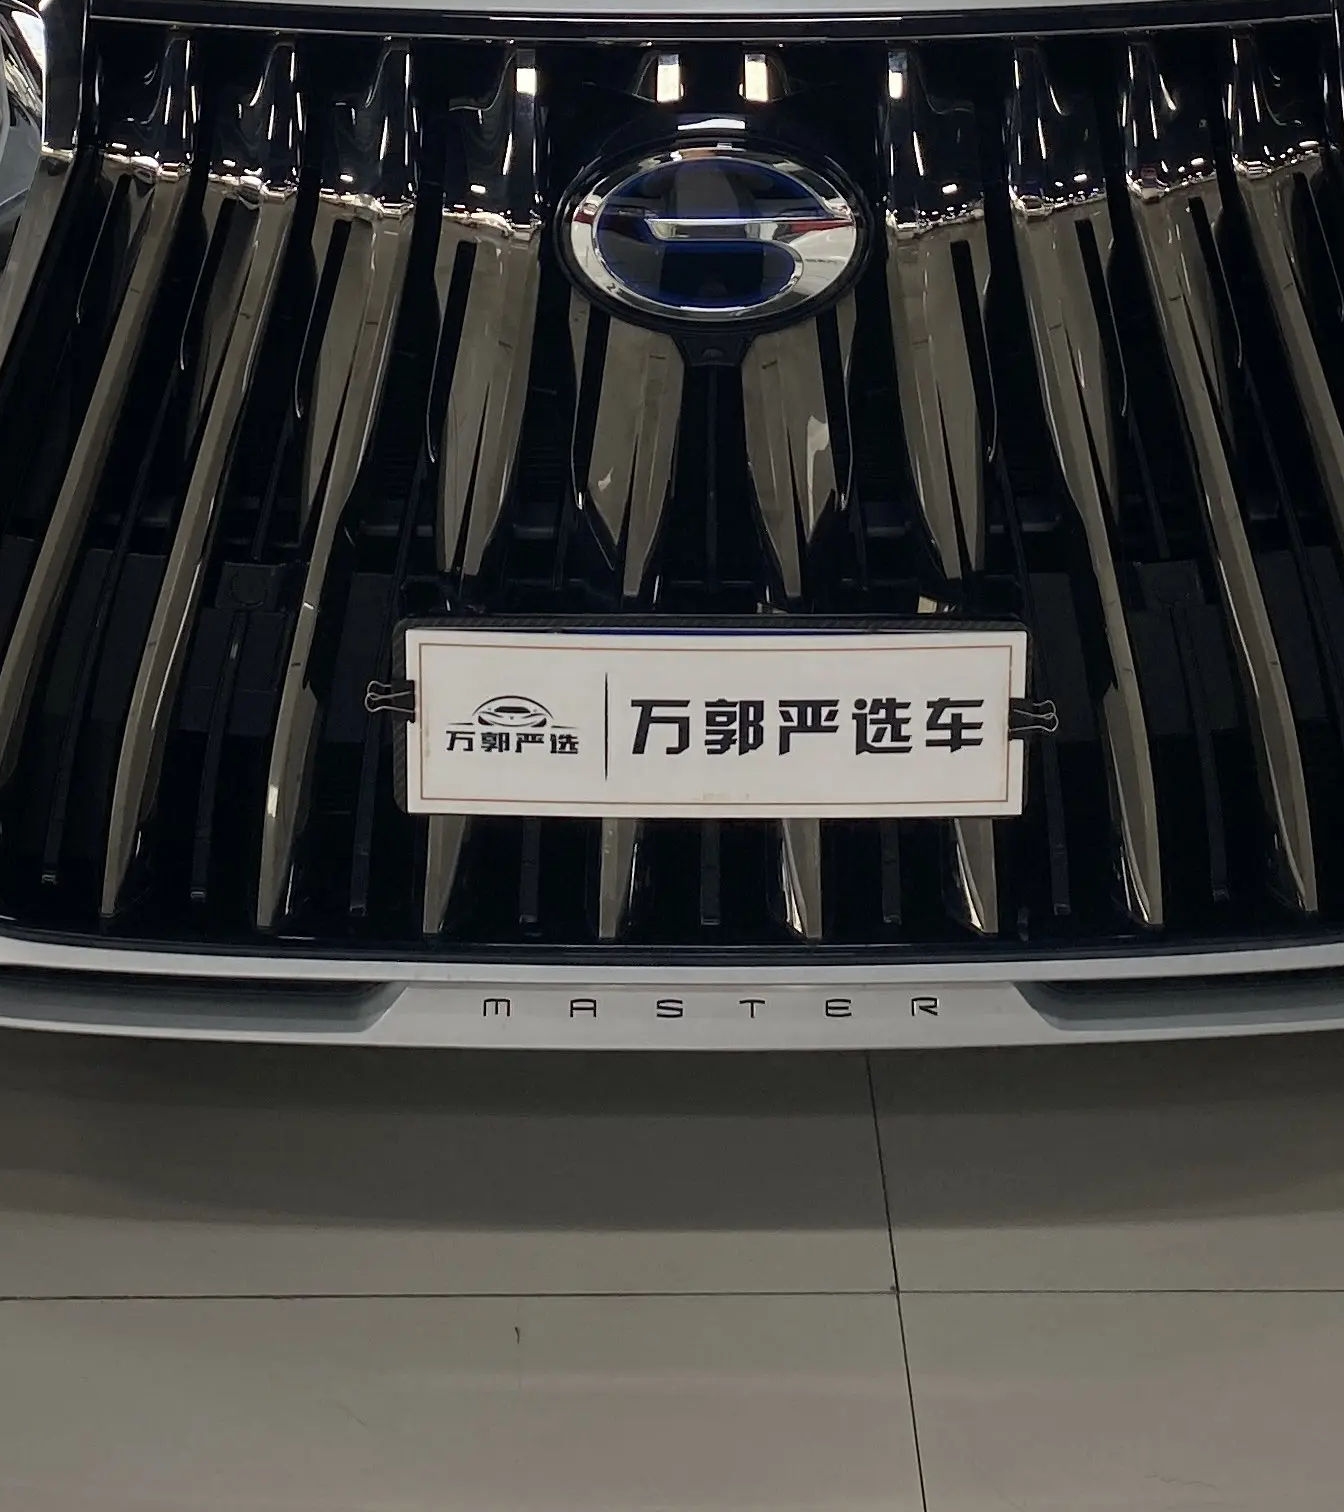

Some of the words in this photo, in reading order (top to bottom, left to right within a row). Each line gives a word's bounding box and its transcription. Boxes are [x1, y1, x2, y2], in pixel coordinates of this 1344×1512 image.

[630, 696, 985, 757] 万郭严选车
[445, 729, 580, 755] 万郭严选
[482, 996, 940, 1019] MASTER
